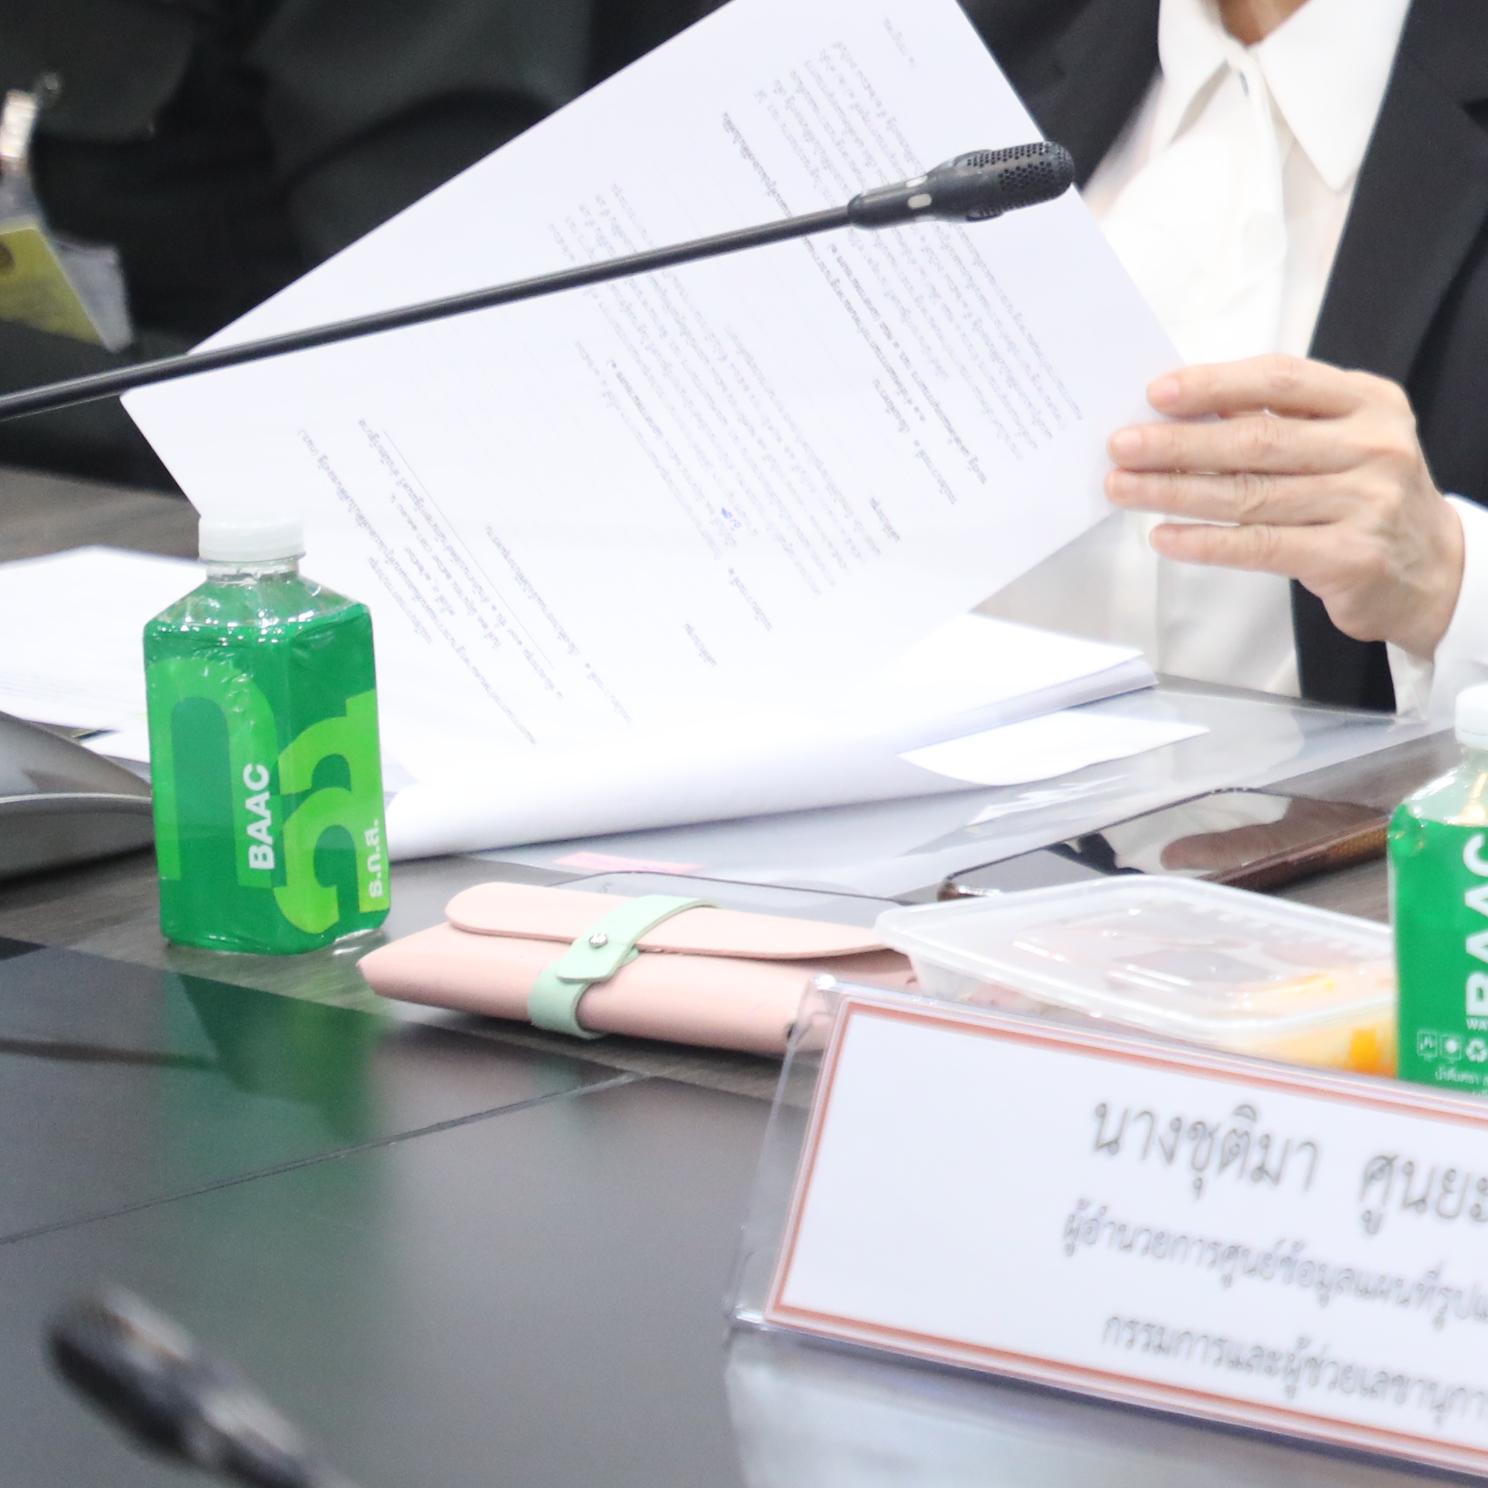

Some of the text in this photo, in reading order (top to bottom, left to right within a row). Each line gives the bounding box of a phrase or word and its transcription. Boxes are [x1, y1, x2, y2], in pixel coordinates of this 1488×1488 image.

[242, 763, 275, 871] BAAC
[1094, 1102, 1318, 1200] นางชุติมา
